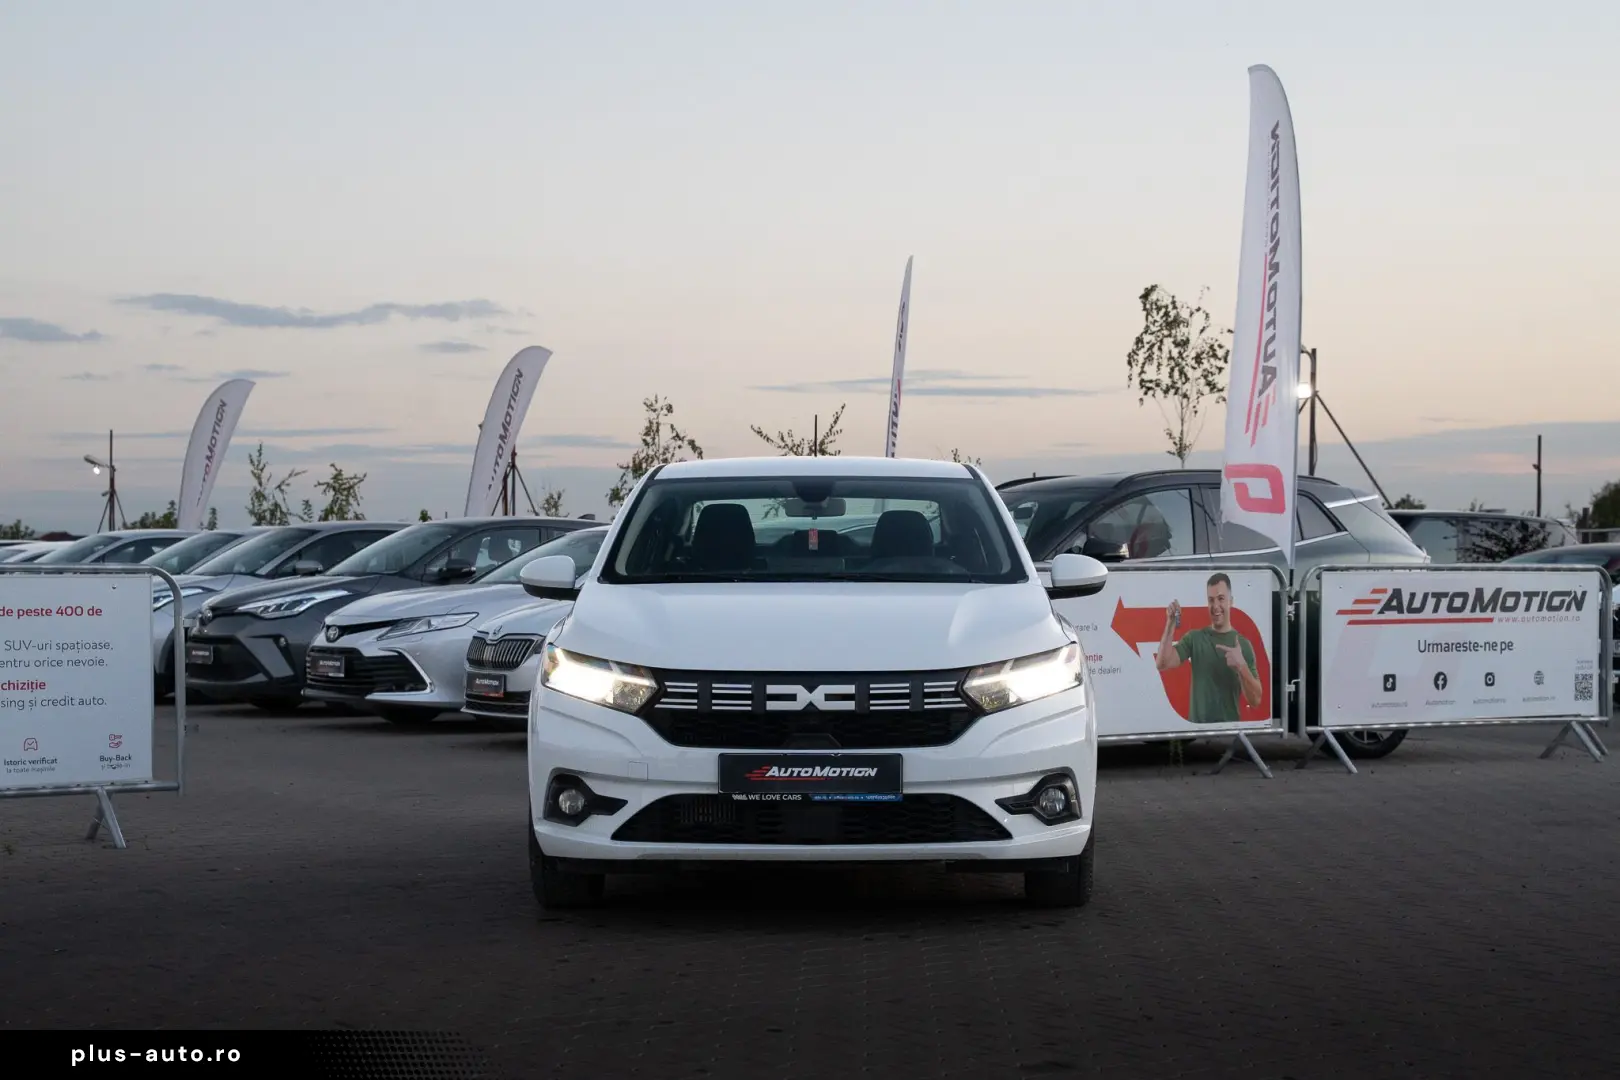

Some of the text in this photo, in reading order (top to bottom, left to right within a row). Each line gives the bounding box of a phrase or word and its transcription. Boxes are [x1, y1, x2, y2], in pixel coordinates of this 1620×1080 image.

[487, 367, 524, 491] TOMOTION
[0, 605, 103, 620] de peste 400 de
[4, 639, 114, 653] SUV-uri spațioase.
[1417, 640, 1514, 655] Urmareste-ne pe
[34, 657, 63, 668] orice
[66, 656, 108, 667] nevoie.
[28, 697, 37, 711] și
[40, 695, 75, 707] credit
[78, 696, 107, 706] auto.
[3, 756, 58, 766] Istoric verificat
[99, 753, 132, 763] Buy-Back
